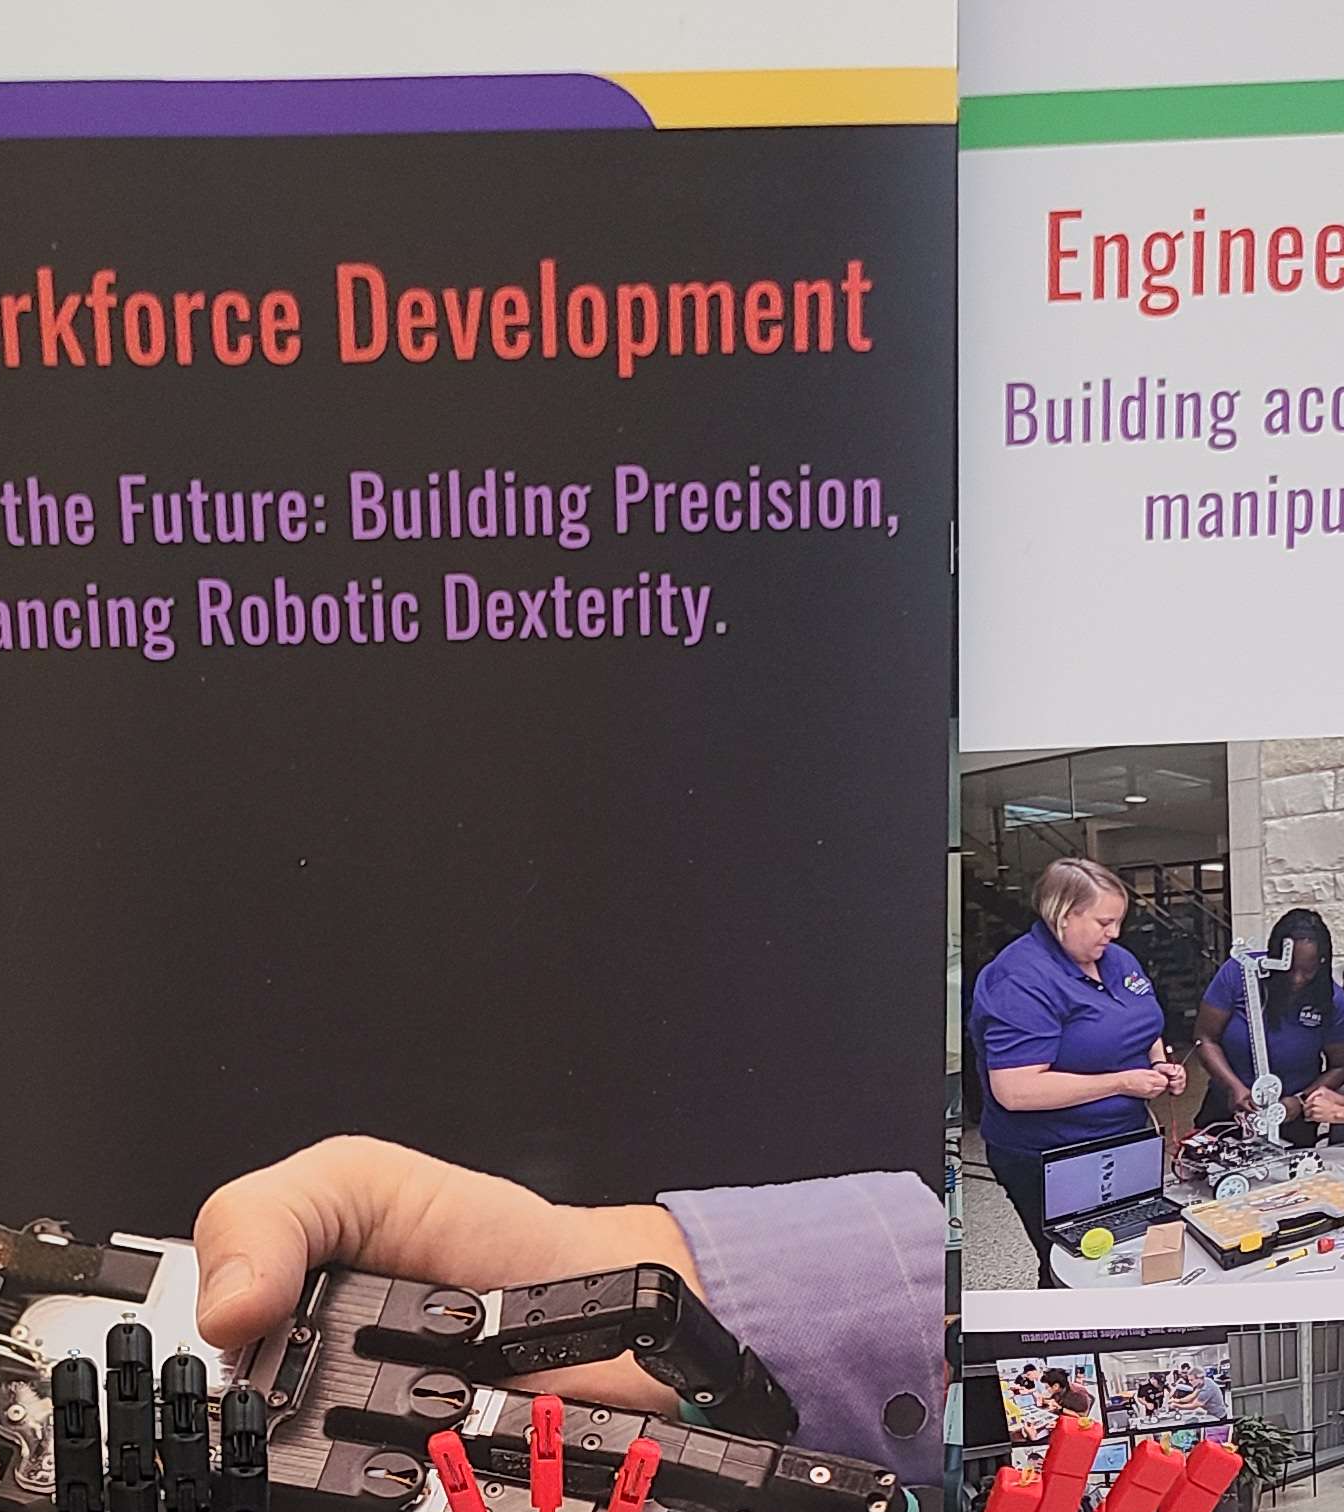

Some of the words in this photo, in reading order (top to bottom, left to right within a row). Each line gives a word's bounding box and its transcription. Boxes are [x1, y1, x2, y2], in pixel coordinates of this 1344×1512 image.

[335, 257, 873, 379] Development
[1004, 376, 1241, 452] Building
[0, 478, 96, 546] the
[119, 474, 323, 546] Future:
[350, 469, 591, 551] Building
[614, 461, 902, 541] Precision,
[197, 575, 418, 646] Robotic
[444, 571, 728, 645] Dexterity.
[1020, 1331, 1081, 1344] manipulation
